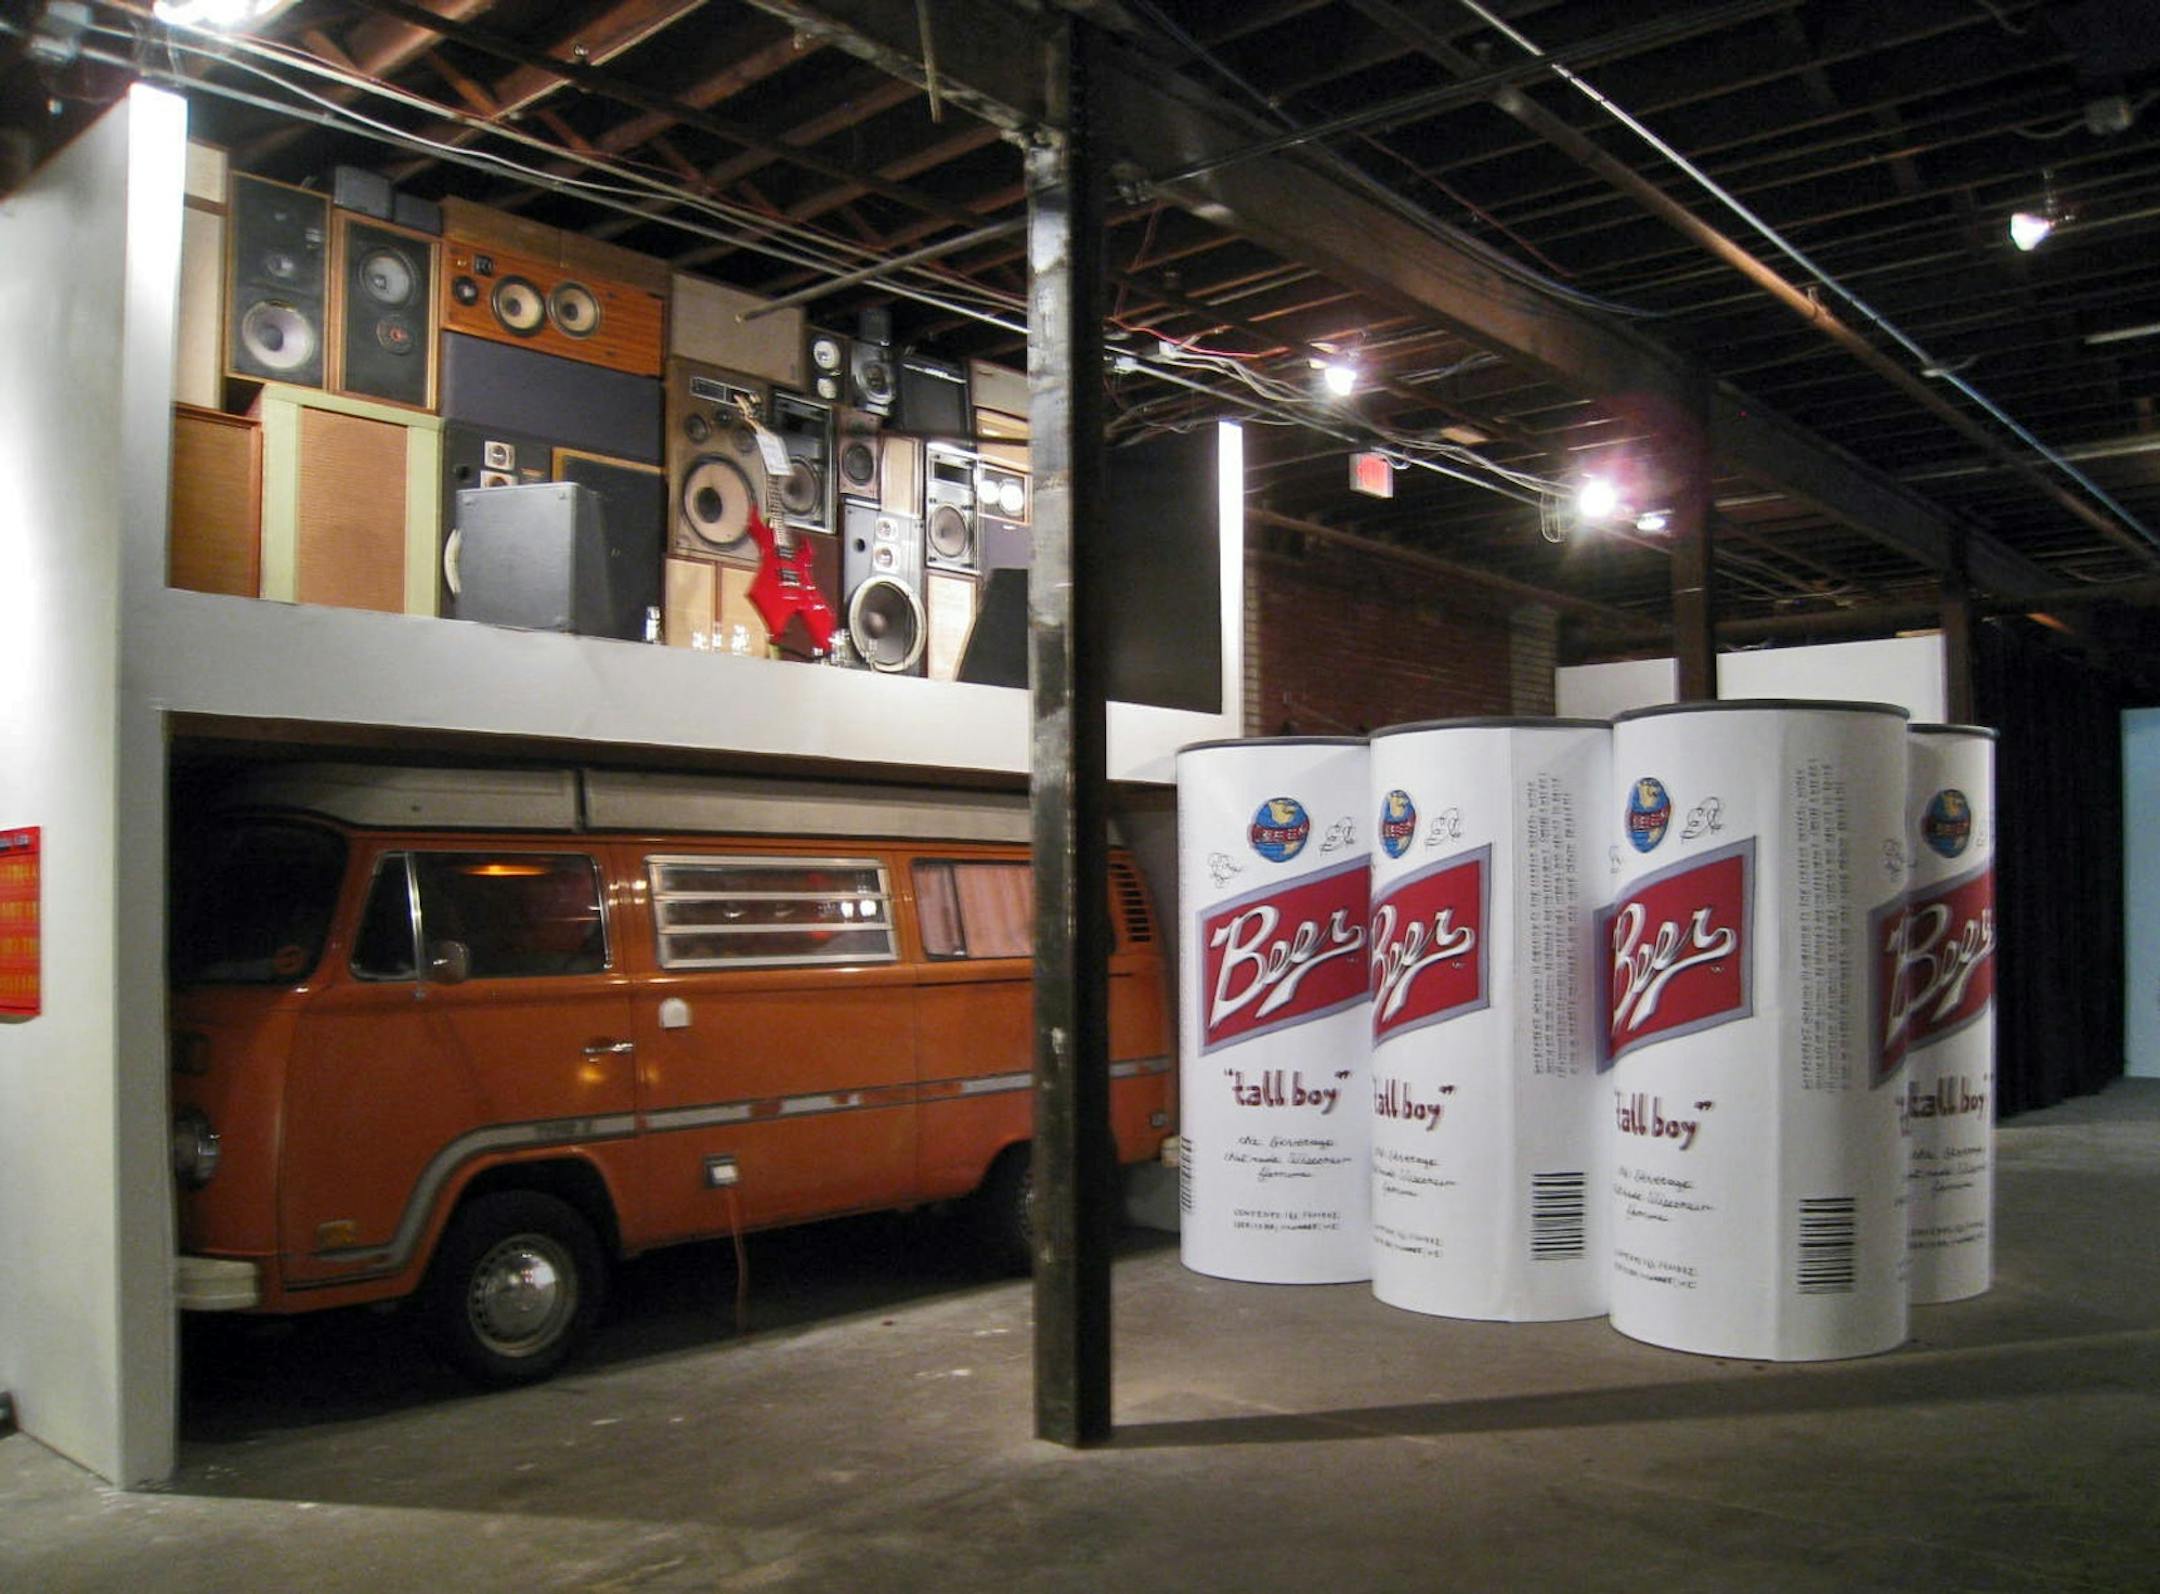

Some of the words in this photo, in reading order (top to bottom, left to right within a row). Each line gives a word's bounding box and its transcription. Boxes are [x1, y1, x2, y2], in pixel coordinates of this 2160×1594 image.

[1209, 904, 1367, 1029] Beer
[1371, 904, 1476, 1030] Beer
[1611, 902, 1738, 1037] Beer
[1223, 1067, 1286, 1109] "tall
[1290, 1068, 1353, 1116] boy"
[1402, 1082, 1458, 1132] boy"
[1651, 1096, 1714, 1152] boy"
